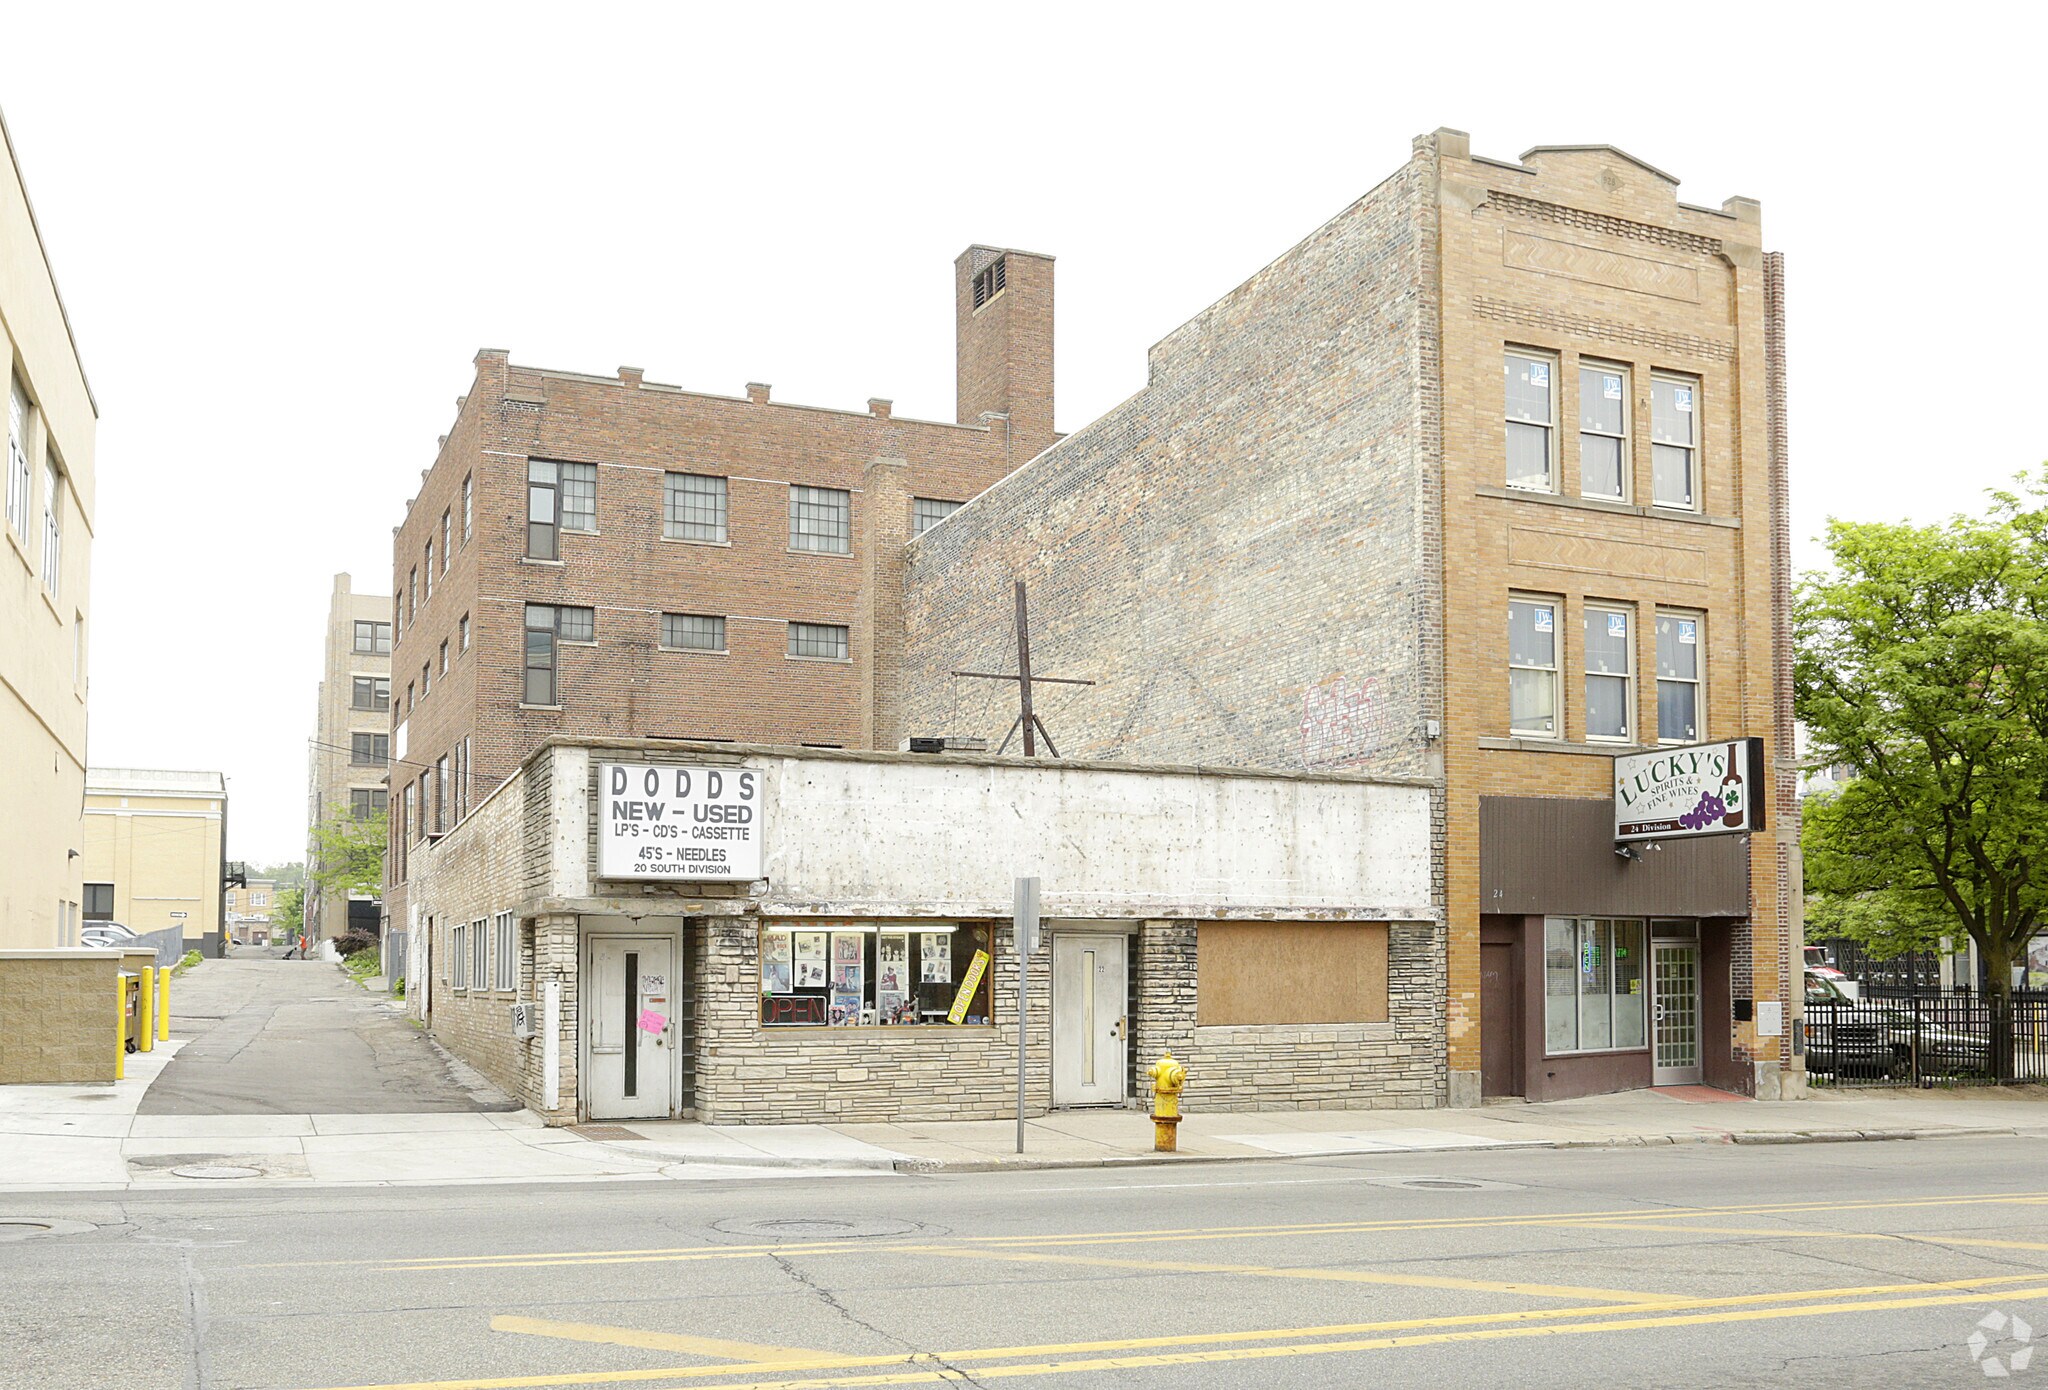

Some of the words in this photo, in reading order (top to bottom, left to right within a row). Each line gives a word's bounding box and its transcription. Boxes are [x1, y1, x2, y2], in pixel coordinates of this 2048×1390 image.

[612, 767, 754, 800] DODDS
[1619, 752, 1725, 807] LUCKY'S
[1650, 776, 1684, 796] SPIRITS
[1686, 775, 1693, 785] &
[1647, 792, 1668, 810] FINE
[1669, 786, 1698, 799] WINES
[612, 801, 665, 821] NEW
[693, 804, 753, 824] USED
[614, 823, 639, 837] LP'S
[653, 825, 678, 838] CD'S
[692, 826, 750, 840] CASSETTE
[1642, 823, 1672, 832] Division
[638, 846, 663, 860] 45'S
[676, 847, 727, 862] NEEDLES
[634, 863, 647, 872] 20
[650, 864, 685, 873] SOUTH
[688, 865, 731, 874] DIVISION
[1493, 889, 1503, 898] 24
[762, 998, 825, 1023] OPEN
[953, 988, 972, 1013] OPEN
